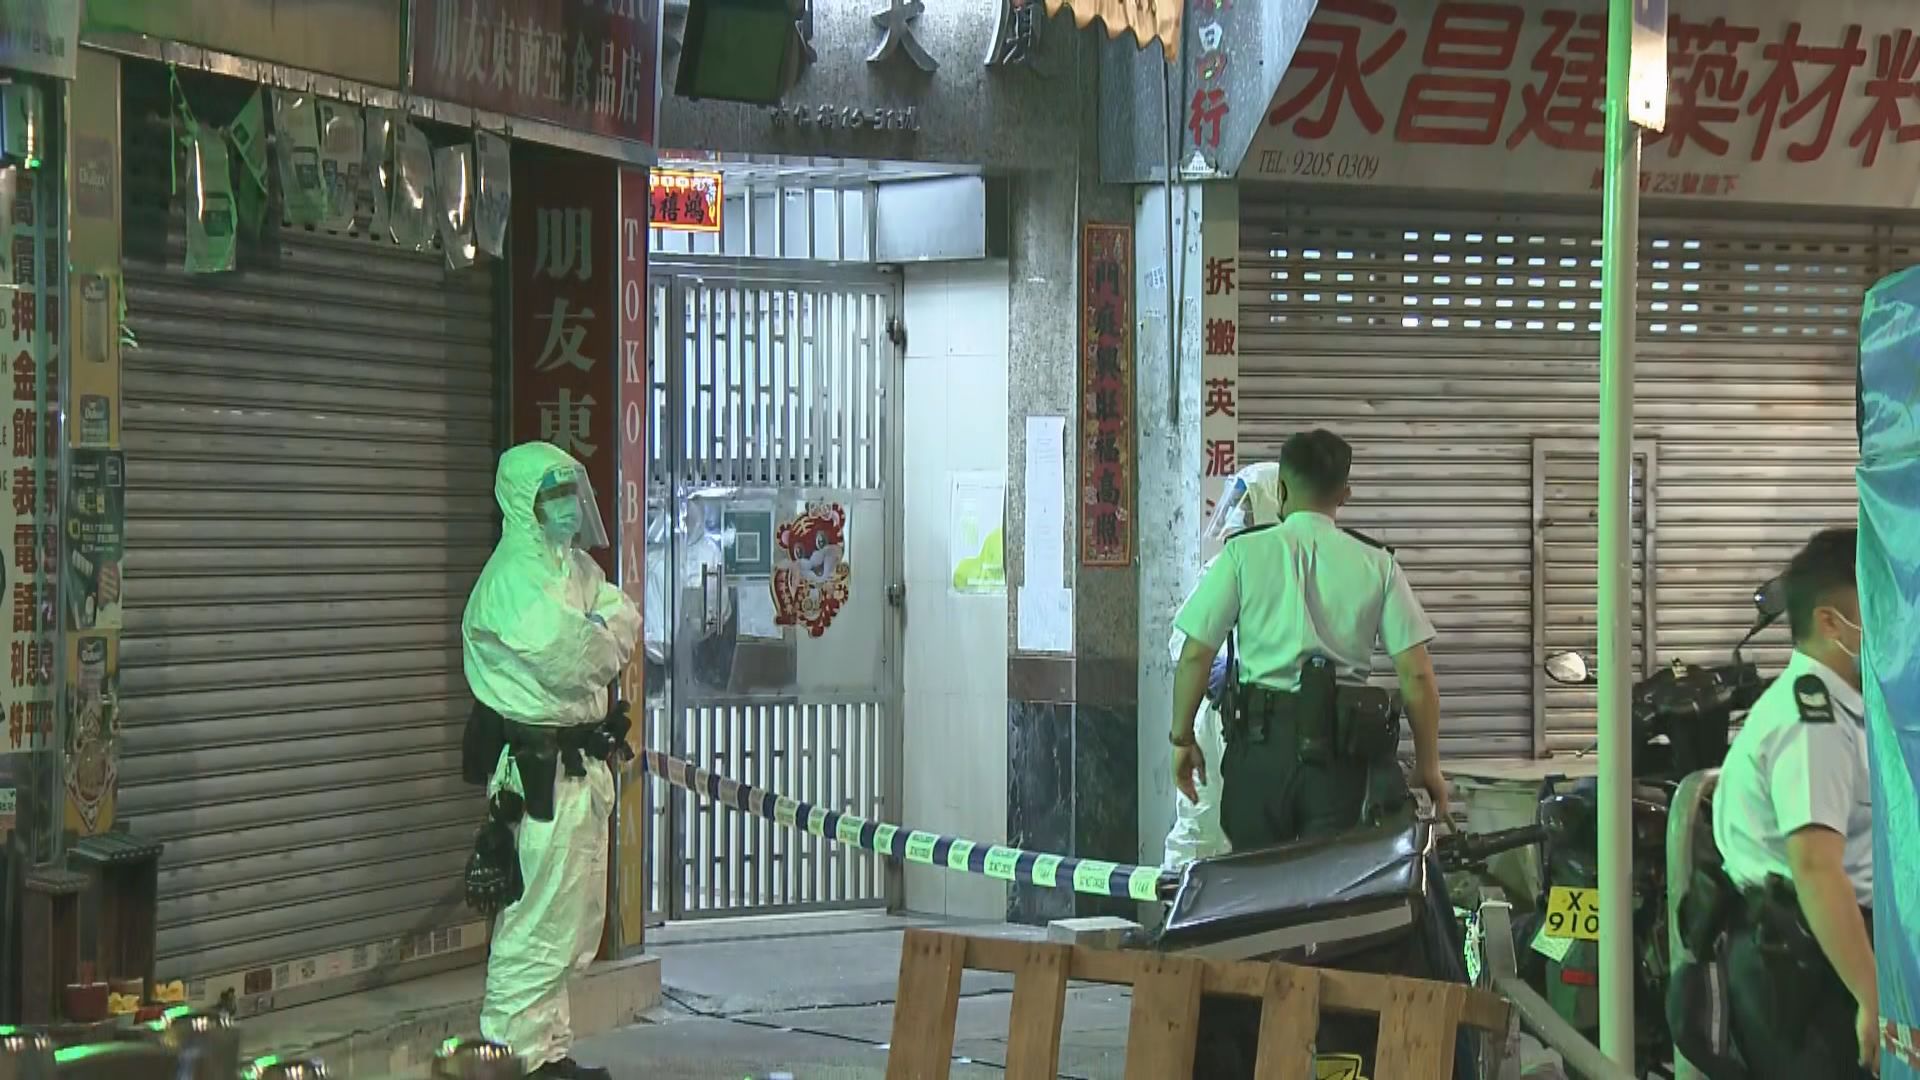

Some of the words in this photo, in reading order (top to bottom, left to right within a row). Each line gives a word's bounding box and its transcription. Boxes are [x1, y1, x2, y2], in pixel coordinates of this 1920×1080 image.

[1292, 151, 1334, 177] 9205
[1336, 153, 1380, 180] 0309
[533, 205, 597, 458] 朋友東
[623, 218, 641, 444] TOKO
[1205, 256, 1236, 517] 拆搬英泥
[624, 480, 641, 704] BAG
[1549, 912, 1599, 934] 910
